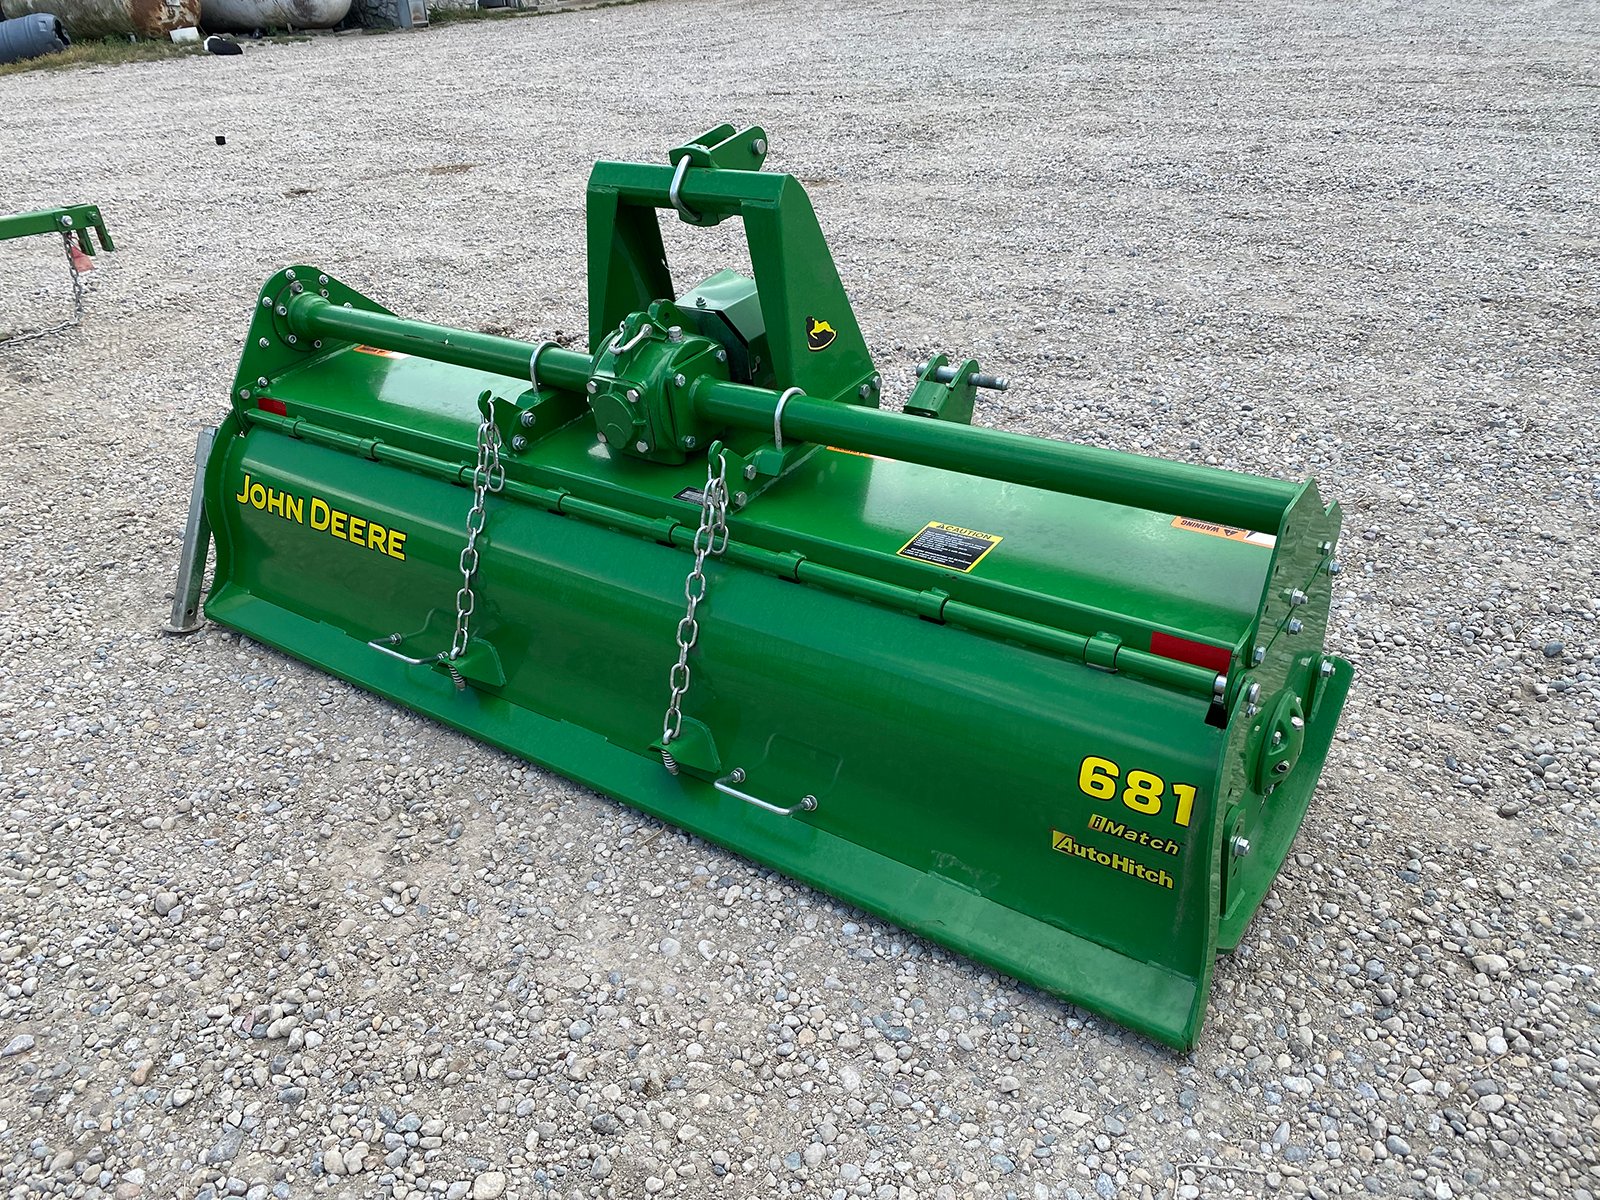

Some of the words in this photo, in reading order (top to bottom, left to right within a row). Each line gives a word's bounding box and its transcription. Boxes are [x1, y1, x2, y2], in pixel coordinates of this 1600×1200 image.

[945, 524, 993, 540] CAUTION
[1180, 519, 1220, 533] WARNING
[1078, 755, 1198, 827] 681
[1088, 814, 1180, 856] iMatch
[1053, 830, 1174, 889] AutoHitch
